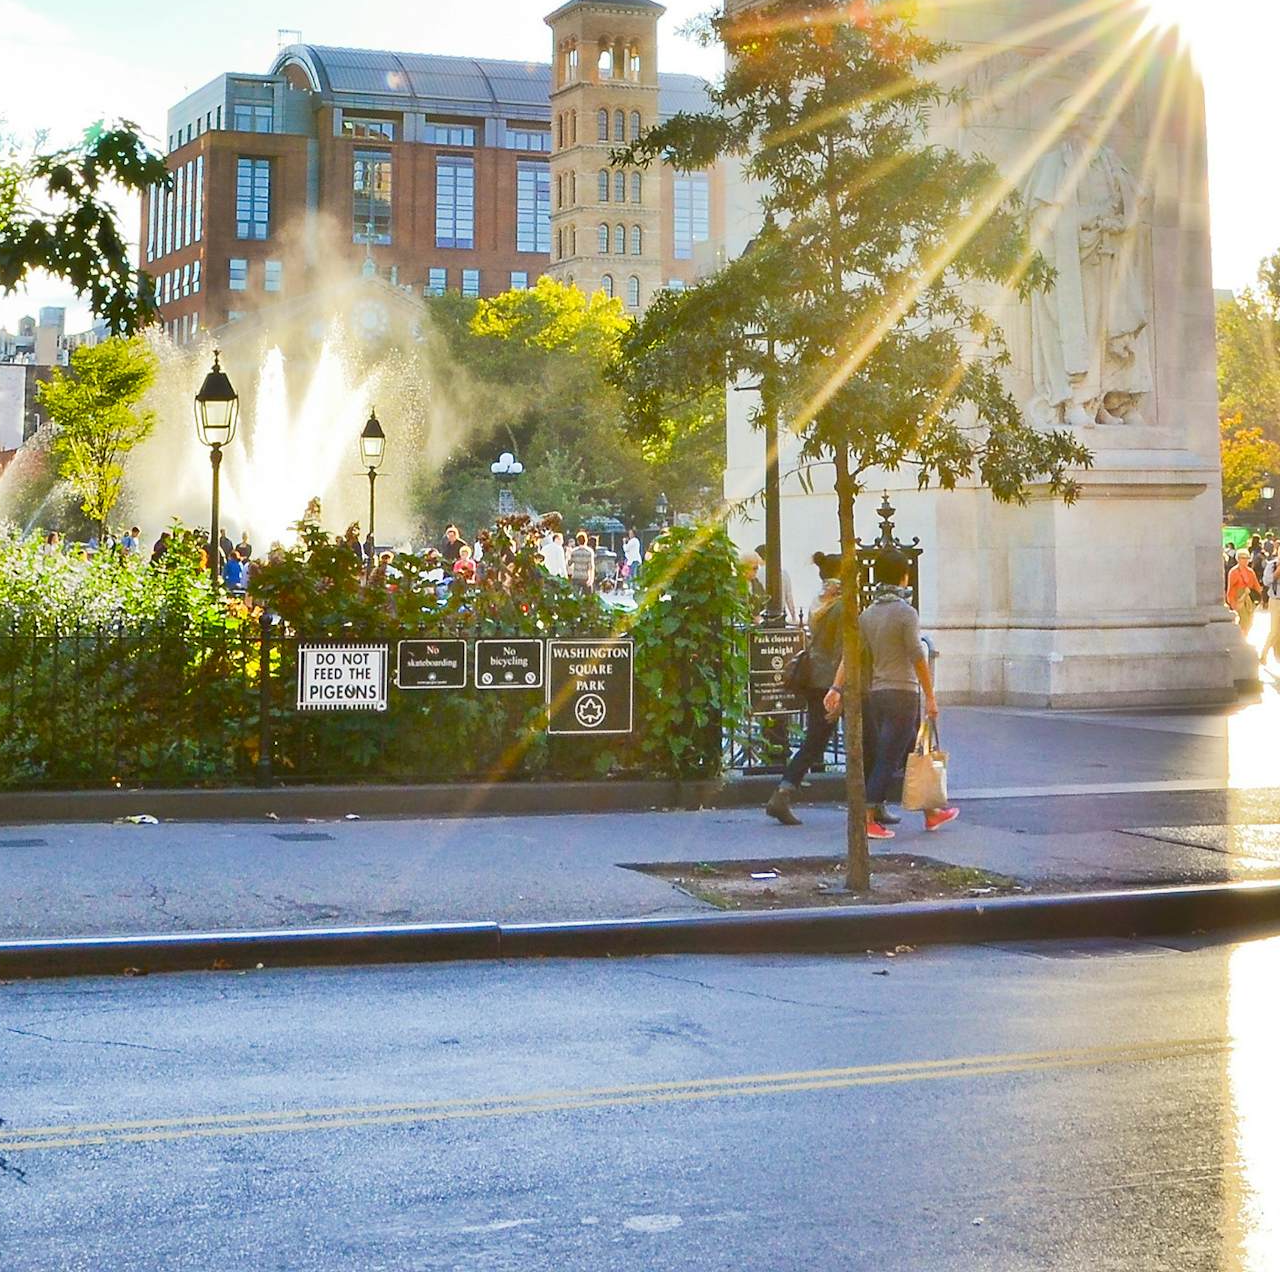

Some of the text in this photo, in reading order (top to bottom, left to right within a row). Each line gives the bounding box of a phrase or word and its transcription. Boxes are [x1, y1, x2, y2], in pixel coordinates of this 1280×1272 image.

[426, 645, 440, 655] No
[503, 647, 516, 656] No
[553, 647, 629, 658] WASHINGTON
[760, 646, 793, 656] midnight
[316, 653, 370, 665] DO NOT
[407, 658, 457, 668] skateboarding
[490, 656, 529, 667] bicycling
[314, 668, 371, 680] FEED THE
[569, 664, 613, 677] SQUARE
[576, 680, 605, 691] PARK
[310, 684, 377, 699] PIGEONS
